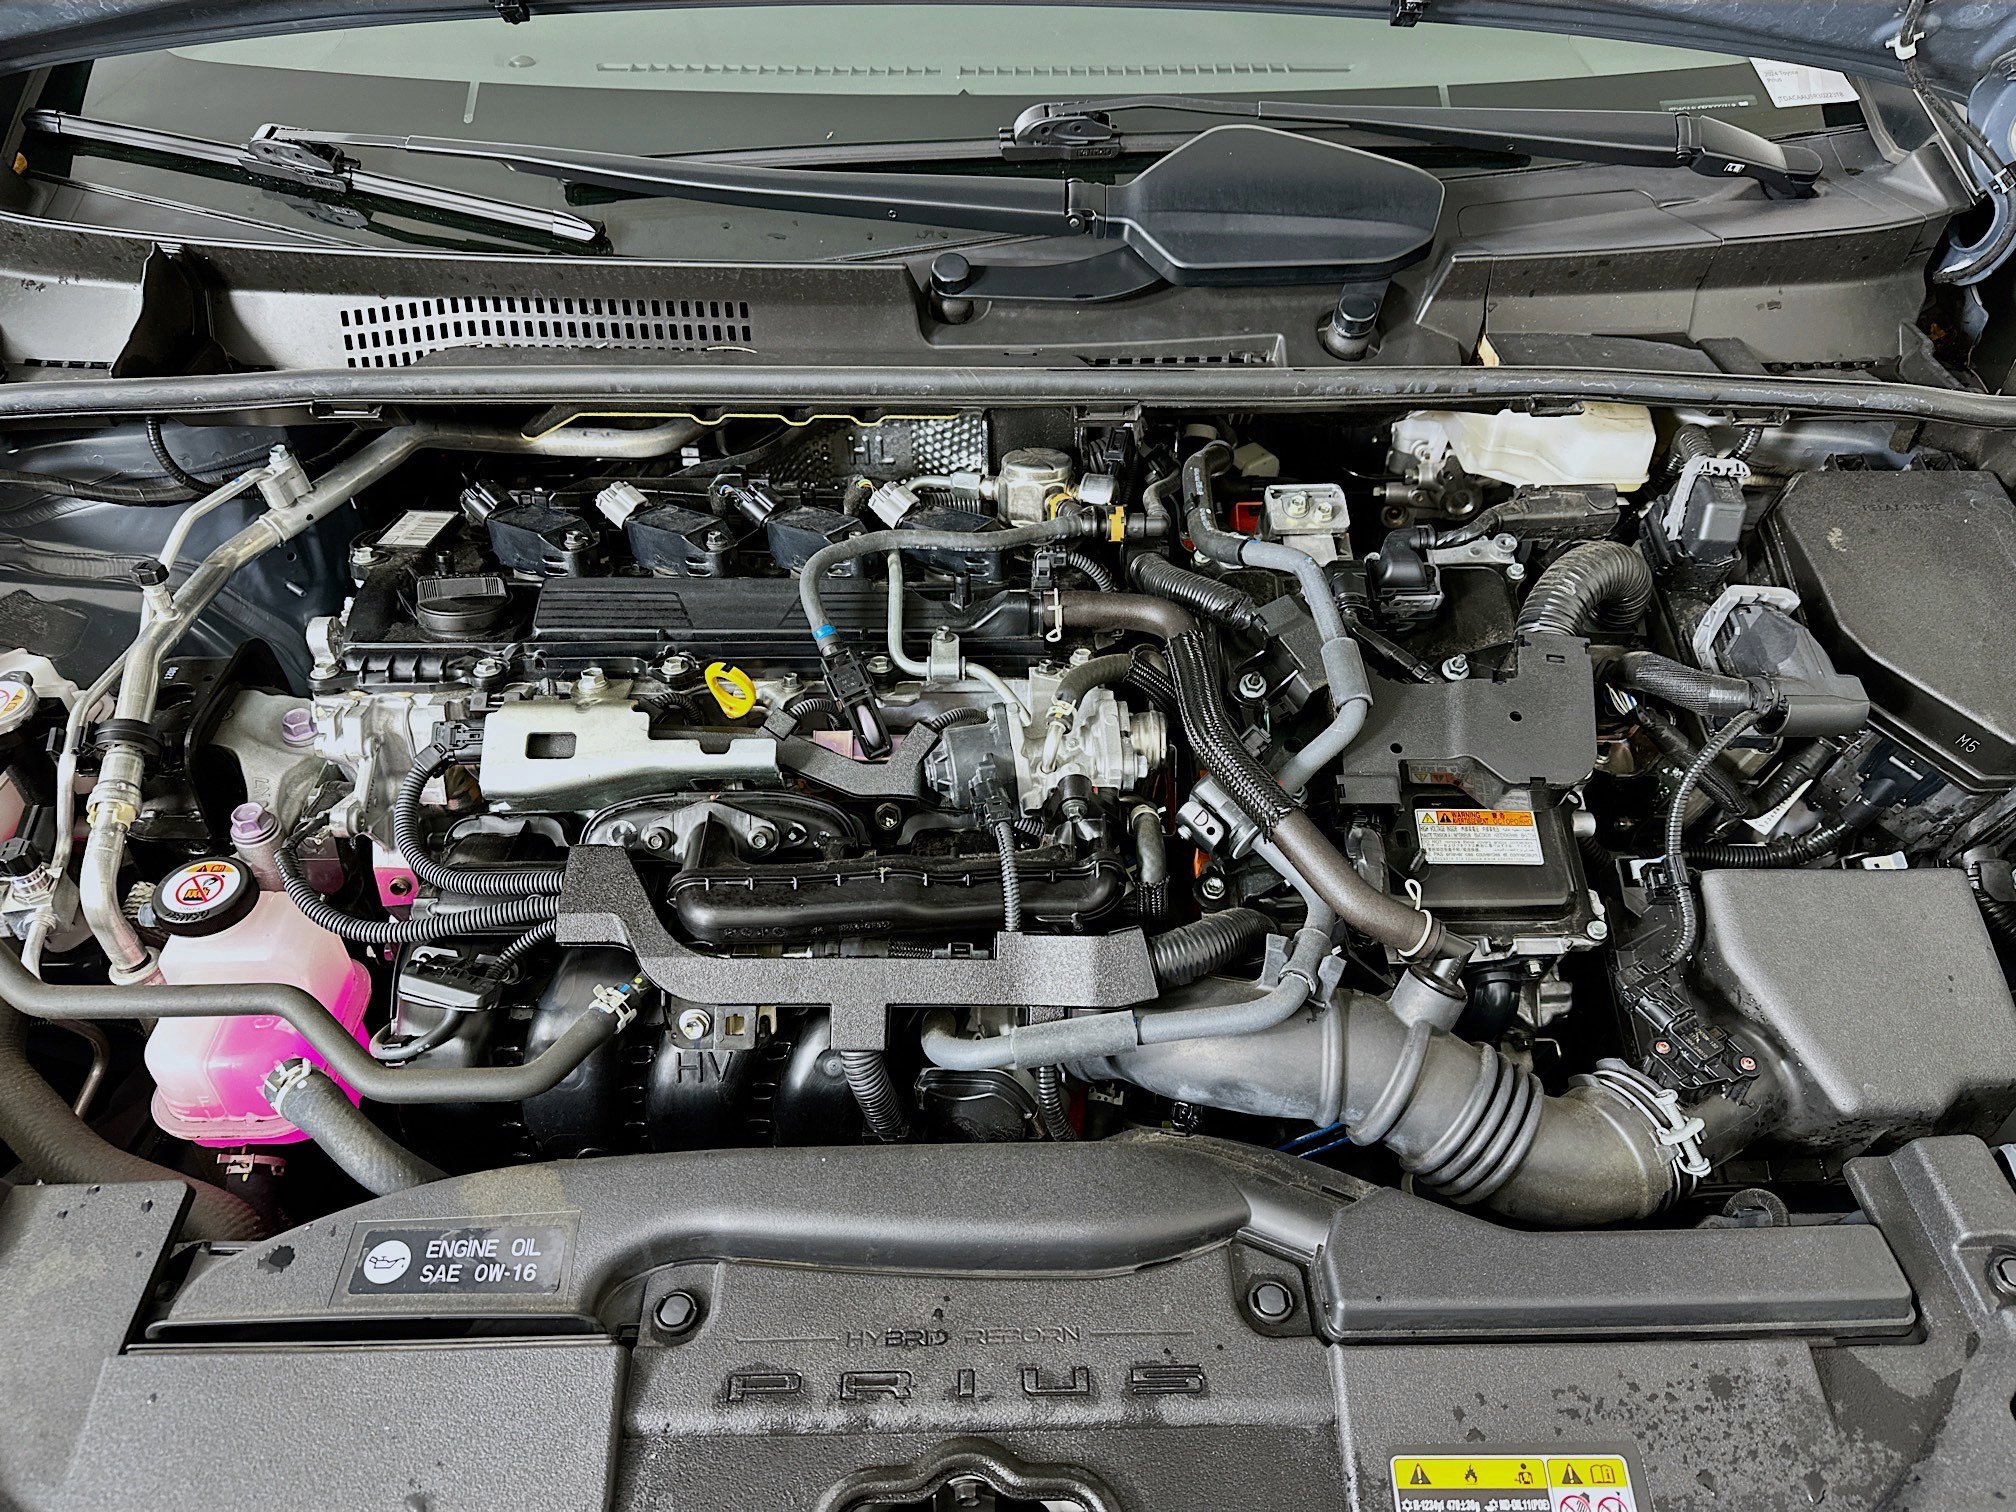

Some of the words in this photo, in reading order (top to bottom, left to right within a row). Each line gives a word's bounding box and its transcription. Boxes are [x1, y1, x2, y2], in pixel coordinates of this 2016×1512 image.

[1955, 733, 1981, 753] M5
[676, 1051, 735, 1083] HV
[426, 1239, 499, 1258] ENGINE
[511, 1238, 541, 1257] OIL
[419, 1264, 462, 1282] SAE
[474, 1263, 537, 1282] 0W-16
[845, 1329, 949, 1347] HYBRID
[964, 1325, 1082, 1344] REBORN
[727, 1364, 1205, 1400] PRIUS
